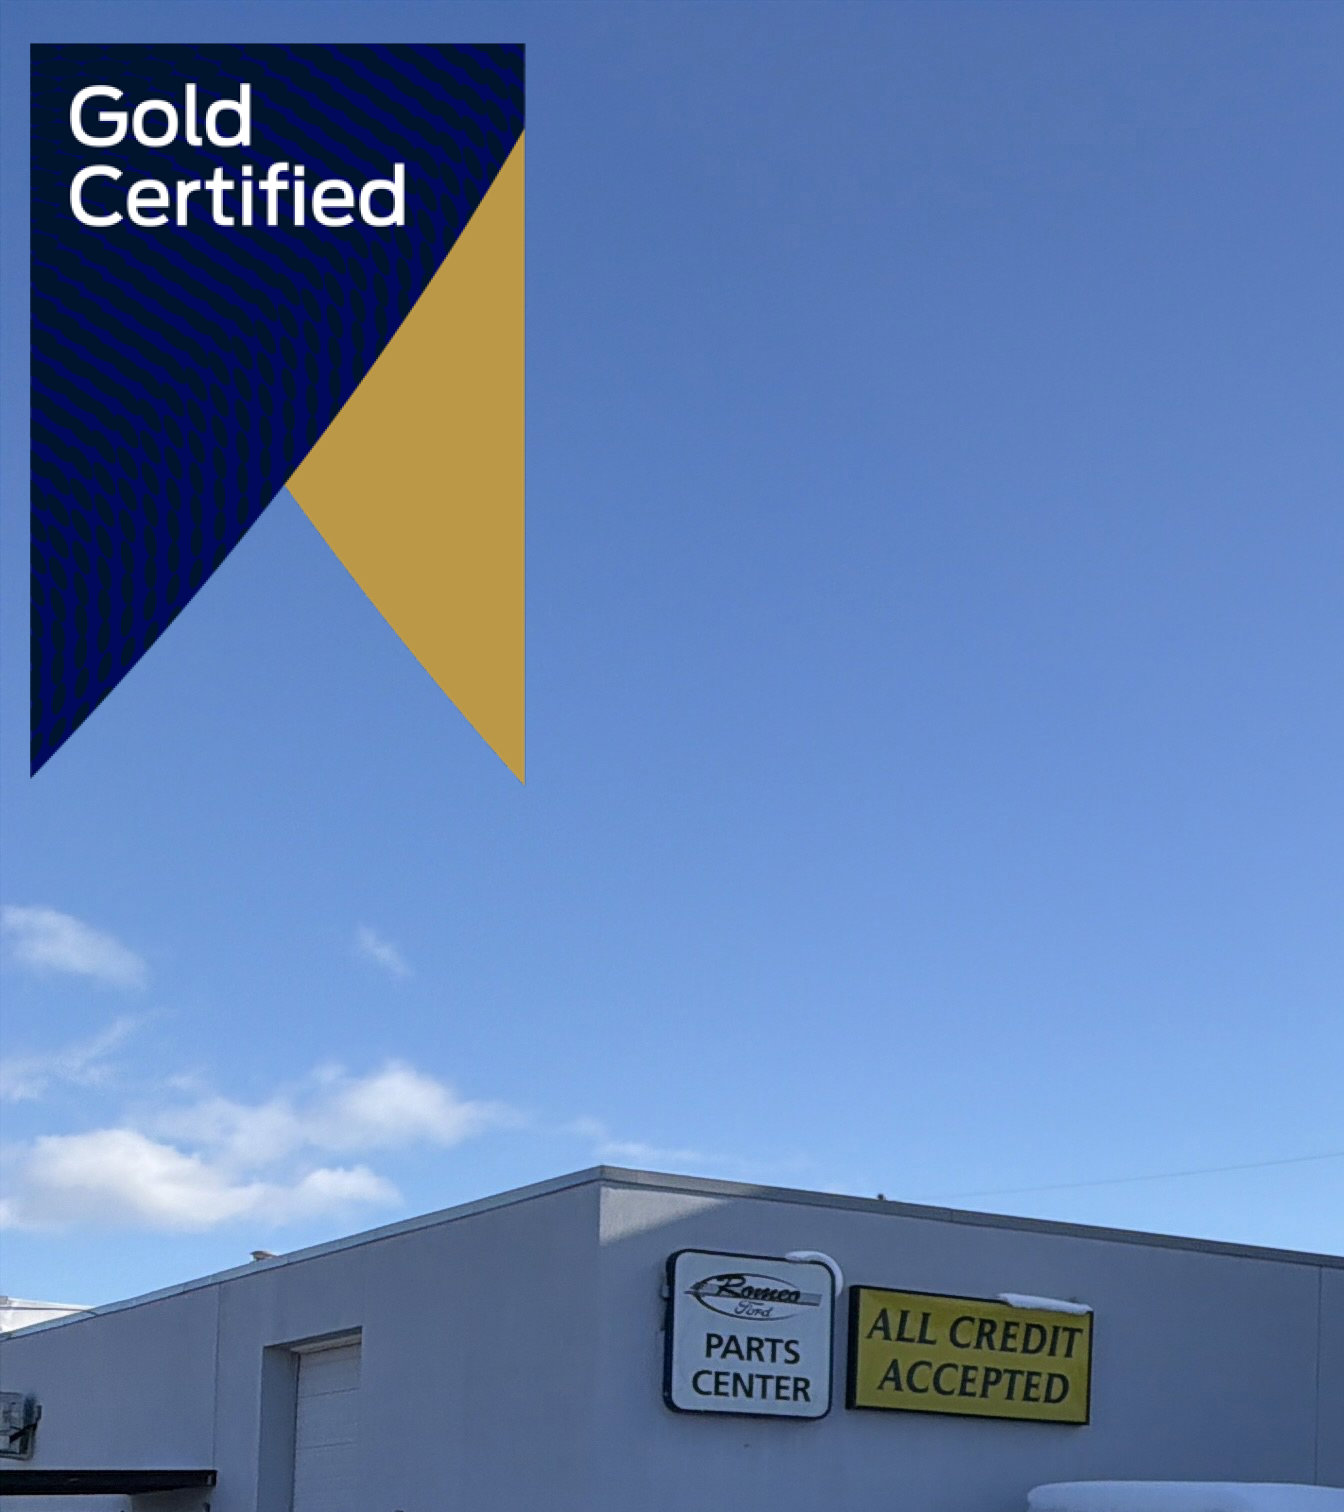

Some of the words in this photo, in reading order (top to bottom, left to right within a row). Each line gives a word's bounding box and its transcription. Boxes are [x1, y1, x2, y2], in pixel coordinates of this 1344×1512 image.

[714, 1273, 803, 1305] Romeo
[733, 1300, 775, 1319] Ford
[704, 1332, 801, 1365] PARTS
[865, 1307, 938, 1347] ALL
[949, 1314, 1084, 1360] CREDIT
[691, 1368, 812, 1403] CENTER
[877, 1358, 1071, 1405] ACCEPTED
